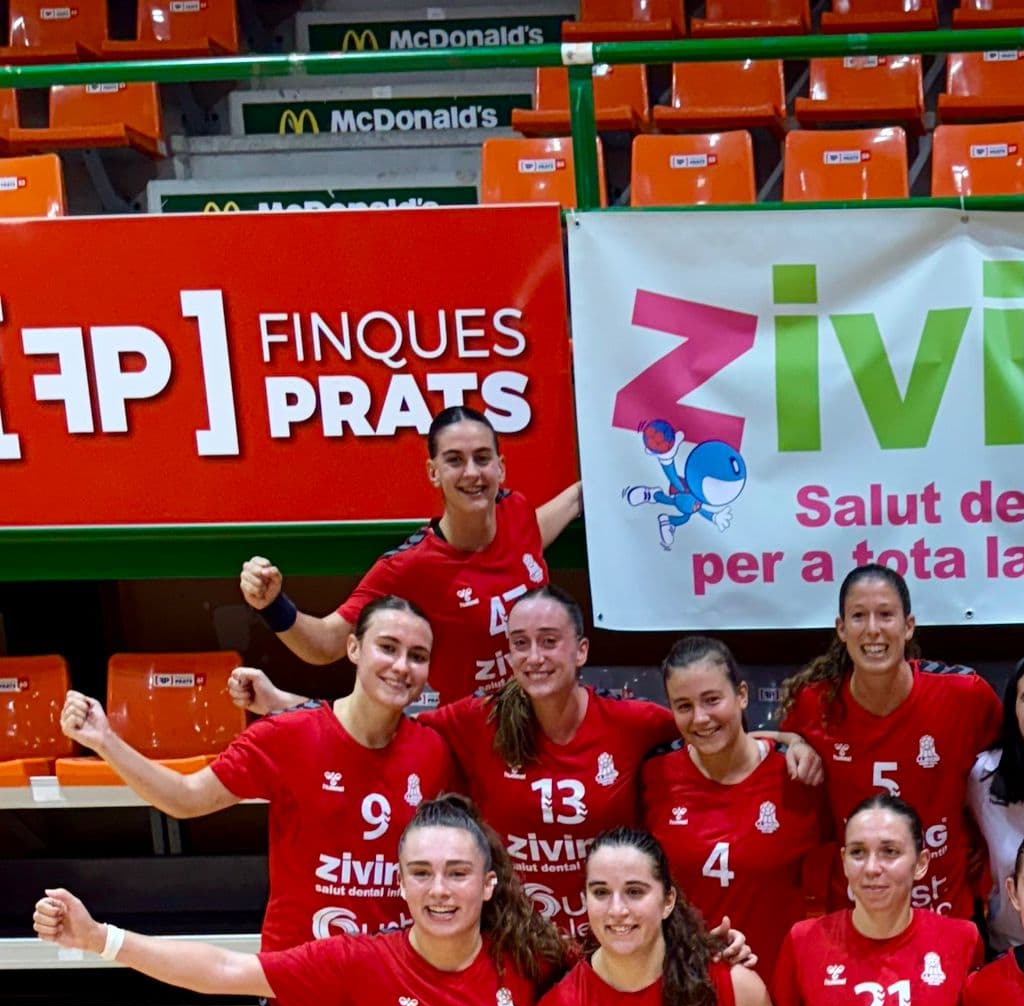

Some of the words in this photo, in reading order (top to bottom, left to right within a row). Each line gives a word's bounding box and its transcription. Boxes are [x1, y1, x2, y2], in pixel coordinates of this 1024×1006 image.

[390, 25, 544, 49] McDonald's
[330, 105, 499, 134] McDonald's
[258, 308, 527, 368] FINQUES
[265, 371, 532, 439] PRATS
[796, 483, 942, 528] Salut
[692, 551, 784, 597] per
[801, 554, 834, 584] a
[853, 541, 967, 580] tota
[490, 584, 528, 640] 4
[361, 792, 392, 841] 9
[530, 778, 588, 825] 13
[702, 841, 735, 887] 4
